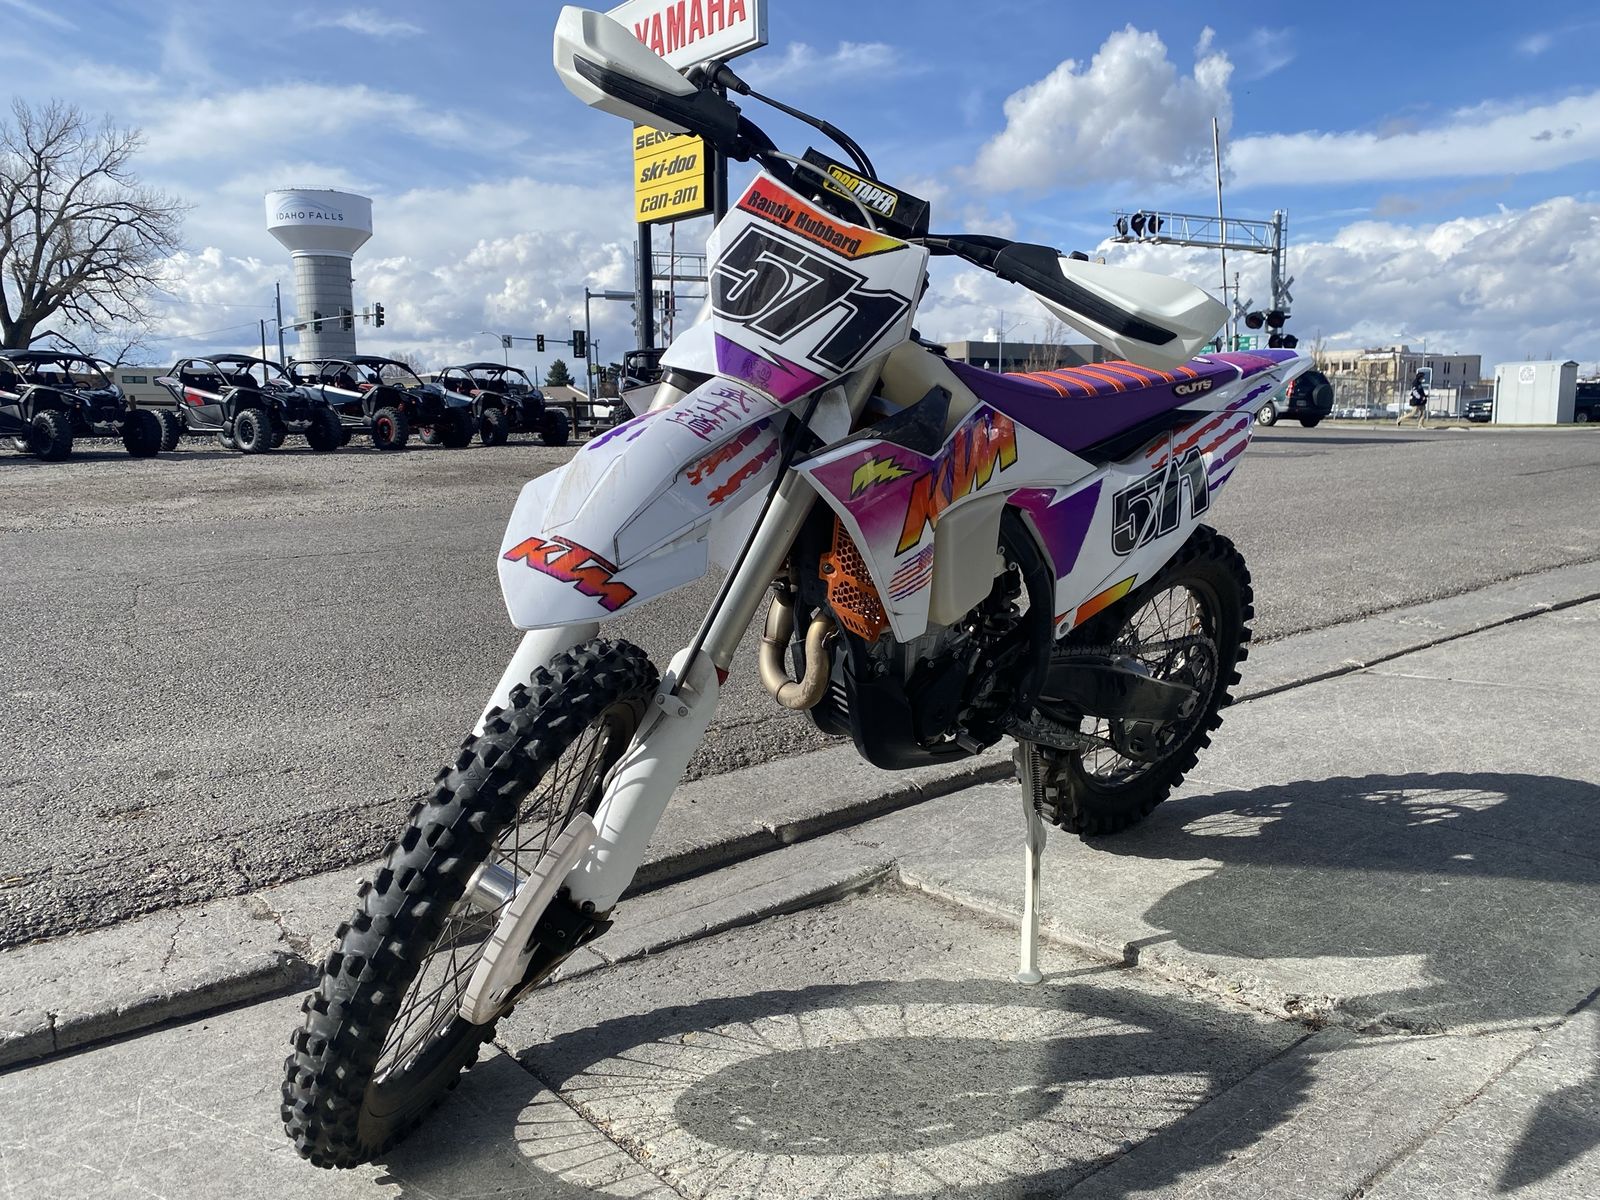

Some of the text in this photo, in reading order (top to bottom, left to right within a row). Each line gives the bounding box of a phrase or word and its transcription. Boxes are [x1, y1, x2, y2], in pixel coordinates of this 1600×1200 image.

[634, 0, 746, 58] YAMAHA
[640, 154, 697, 184] ski-doo
[276, 211, 344, 221] IDAHO FALLS
[640, 185, 698, 213] can-am
[747, 190, 862, 255] Randy Hubbard
[708, 222, 912, 374] 571
[1175, 379, 1213, 395] GUTS
[1111, 445, 1210, 556] 571
[502, 535, 638, 613] KTM
